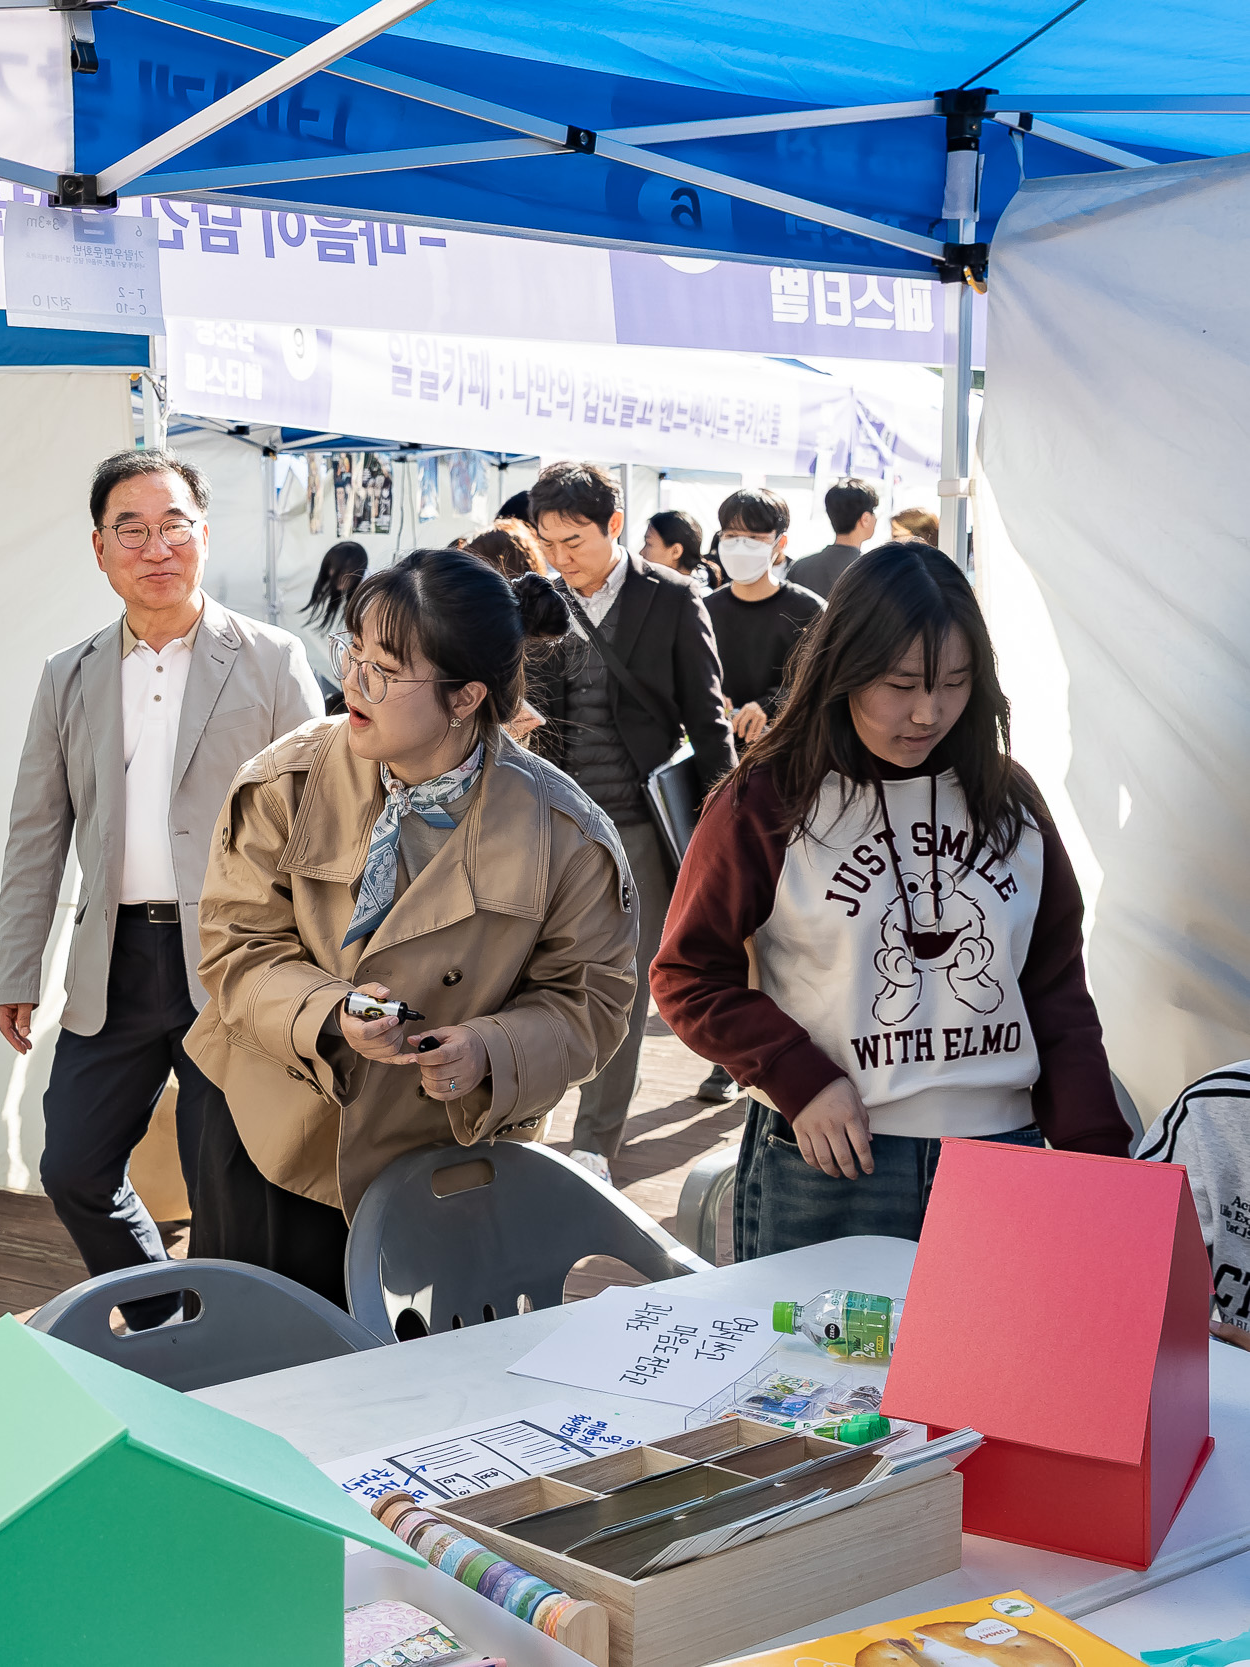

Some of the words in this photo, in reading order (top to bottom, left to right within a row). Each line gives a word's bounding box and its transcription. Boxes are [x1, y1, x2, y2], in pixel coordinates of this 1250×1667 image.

[293, 328, 305, 359] 9
[184, 352, 263, 401] 페스티벌
[388, 333, 490, 410] 일일카페
[512, 357, 575, 422] 나만의
[824, 829, 901, 918] JUST
[912, 821, 1019, 904] SMILE
[851, 1027, 935, 1071] WITH
[943, 1021, 1021, 1061] ELMO
[626, 1302, 673, 1331] 과자도
[979, 1627, 1014, 1640] YUMMY
